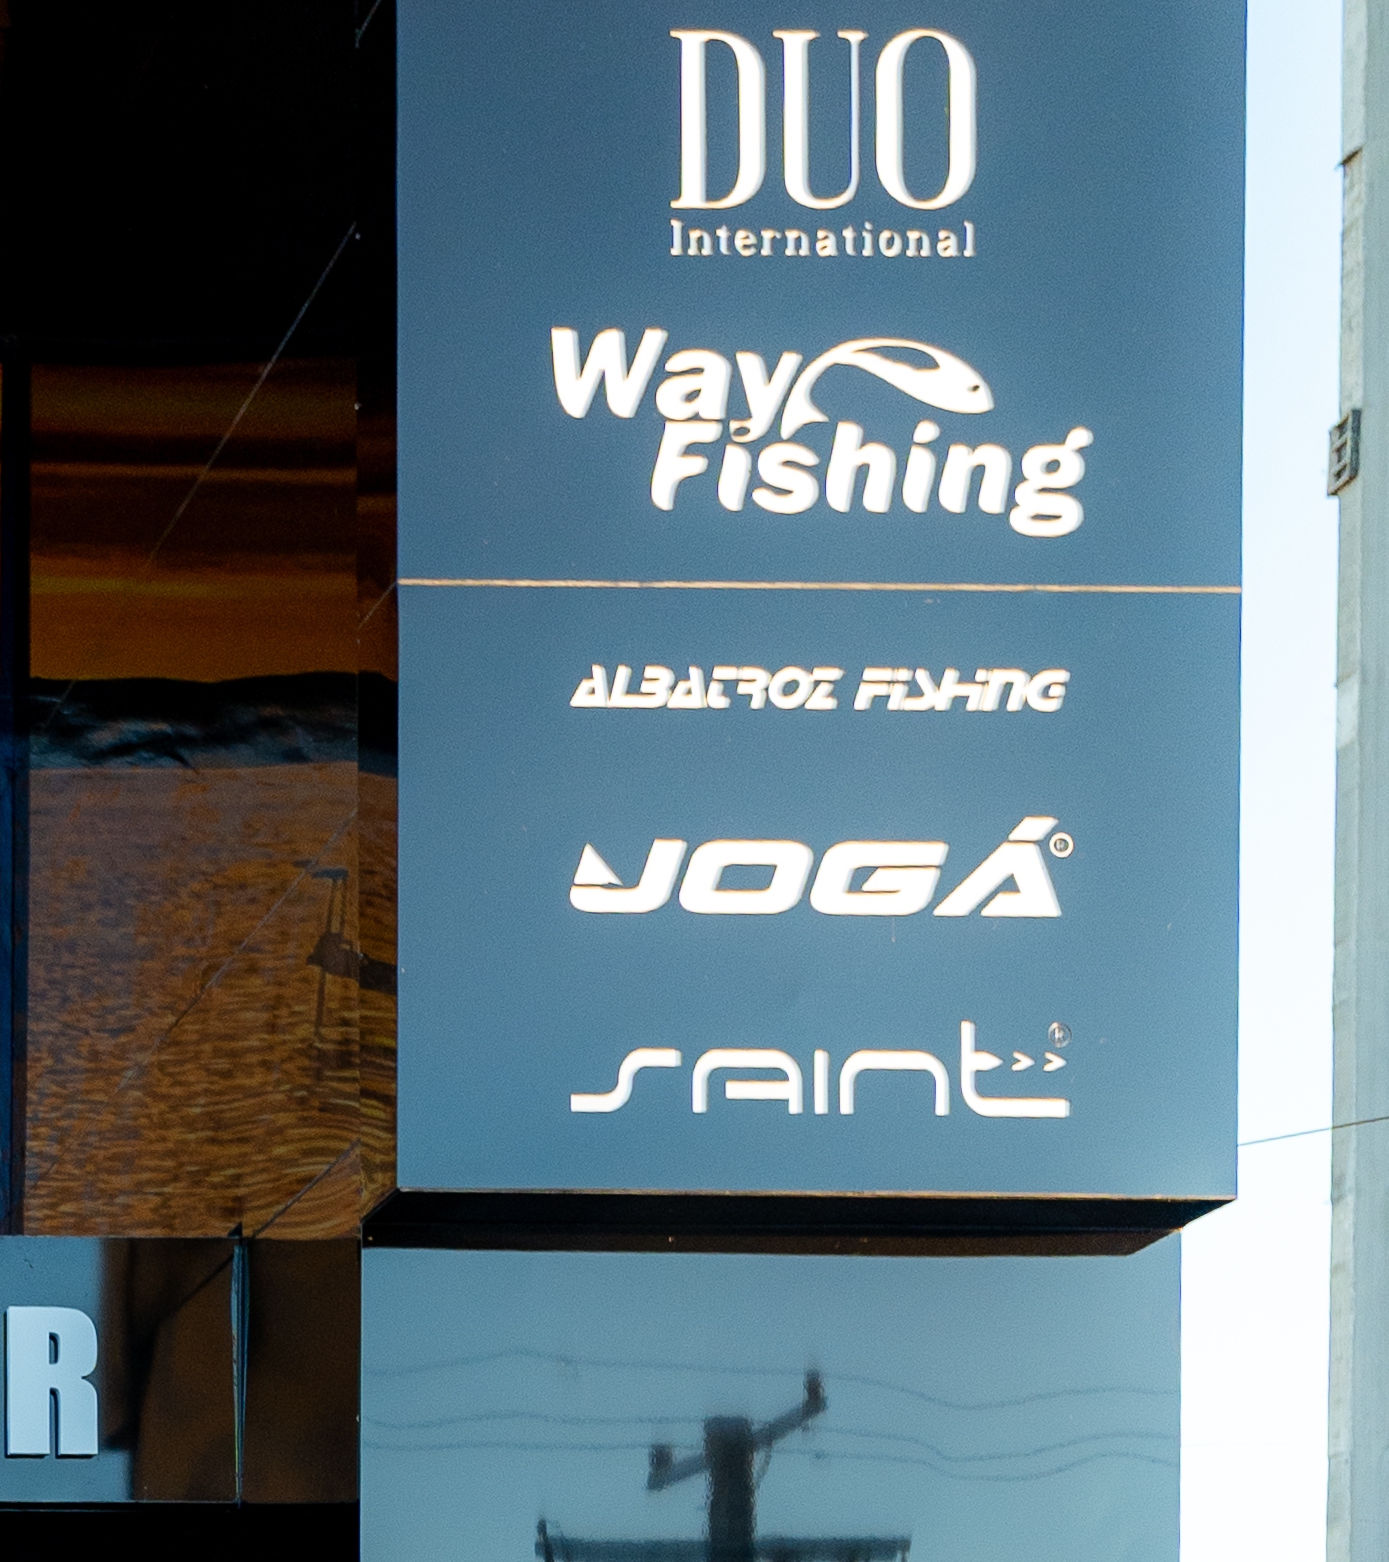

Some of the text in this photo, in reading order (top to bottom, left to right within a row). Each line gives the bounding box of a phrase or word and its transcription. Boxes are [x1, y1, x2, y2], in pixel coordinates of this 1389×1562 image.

[669, 28, 978, 211] DUO
[670, 219, 976, 258] International
[551, 327, 804, 443] Way
[651, 419, 1094, 538] Fishing
